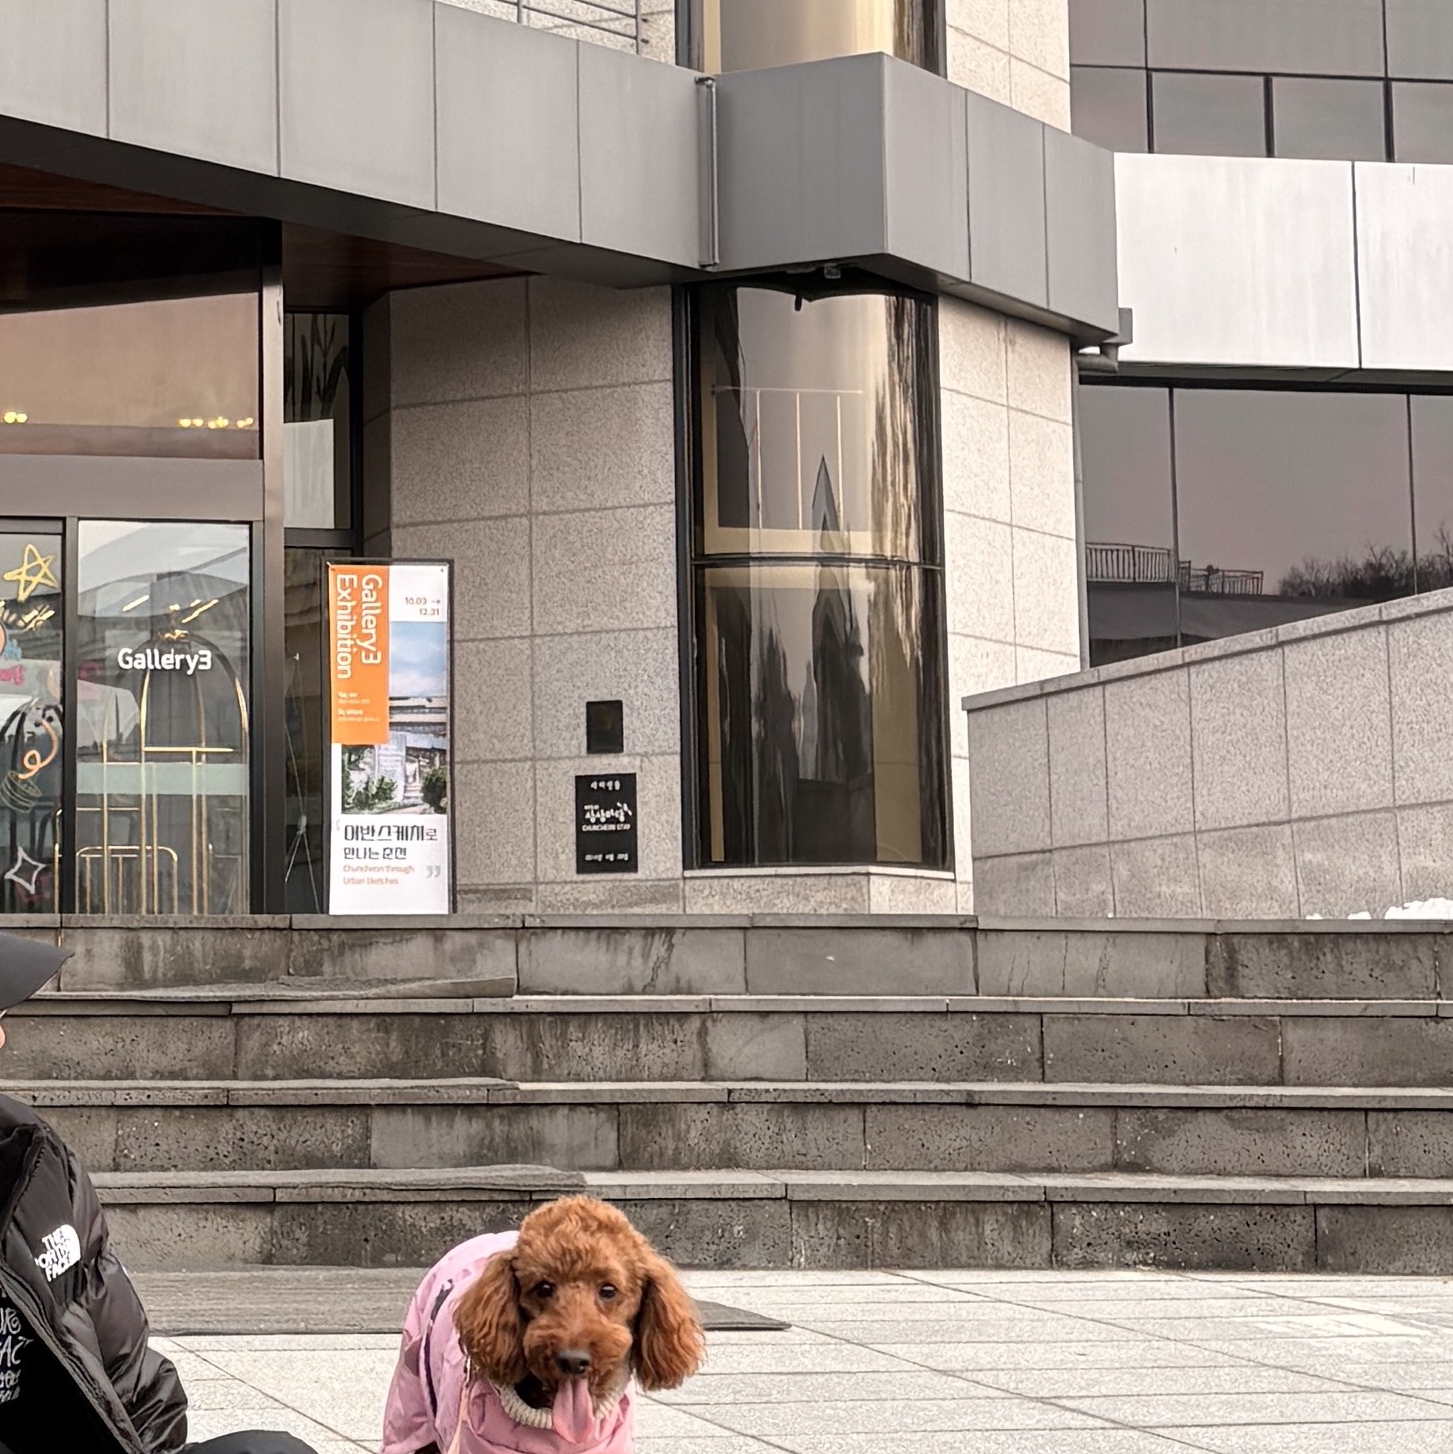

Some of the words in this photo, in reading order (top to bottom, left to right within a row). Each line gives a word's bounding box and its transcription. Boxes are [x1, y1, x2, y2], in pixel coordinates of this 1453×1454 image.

[117, 647, 212, 675] Gallery3
[336, 574, 358, 679] Exhibition
[356, 573, 383, 665] Gallery3
